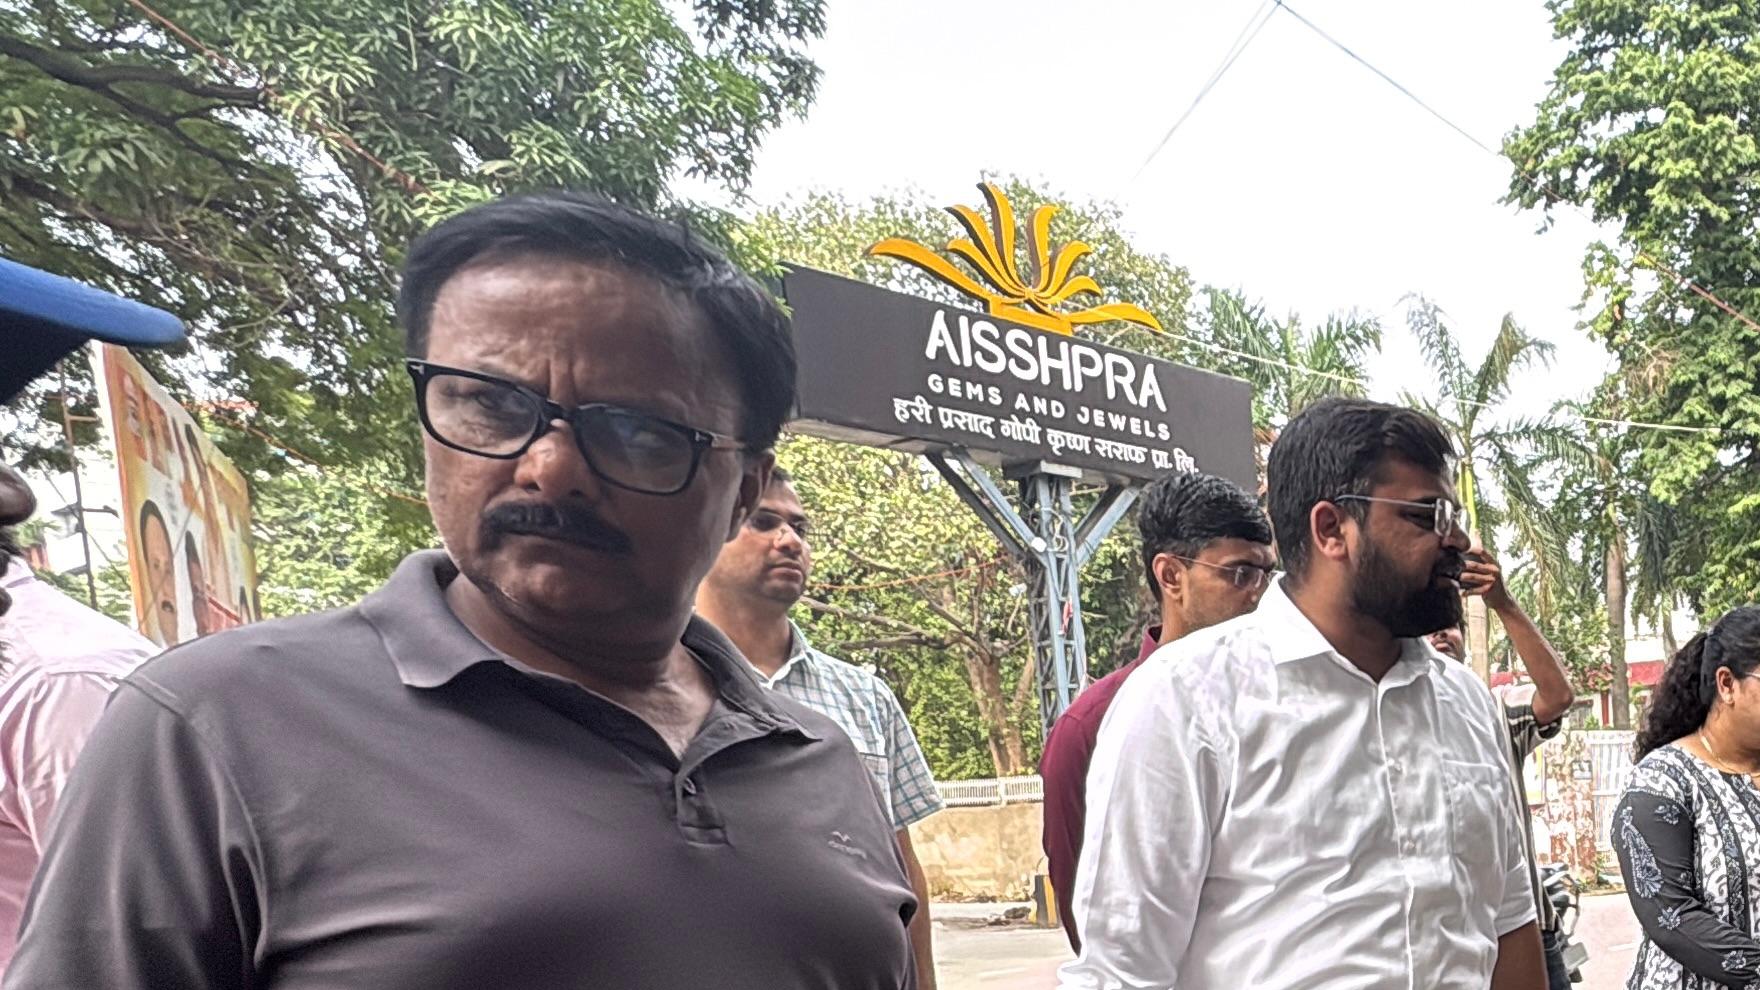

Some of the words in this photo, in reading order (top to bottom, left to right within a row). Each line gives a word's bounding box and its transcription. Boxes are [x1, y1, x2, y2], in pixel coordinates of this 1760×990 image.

[925, 309, 1167, 412] AISSHPRA
[893, 395, 933, 424] हरी
[938, 406, 996, 439] प्रसाद
[1000, 414, 1041, 445] गोपी
[927, 373, 1002, 405] GEMS
[1015, 392, 1066, 418] AND
[1076, 406, 1170, 441] JEWELS
